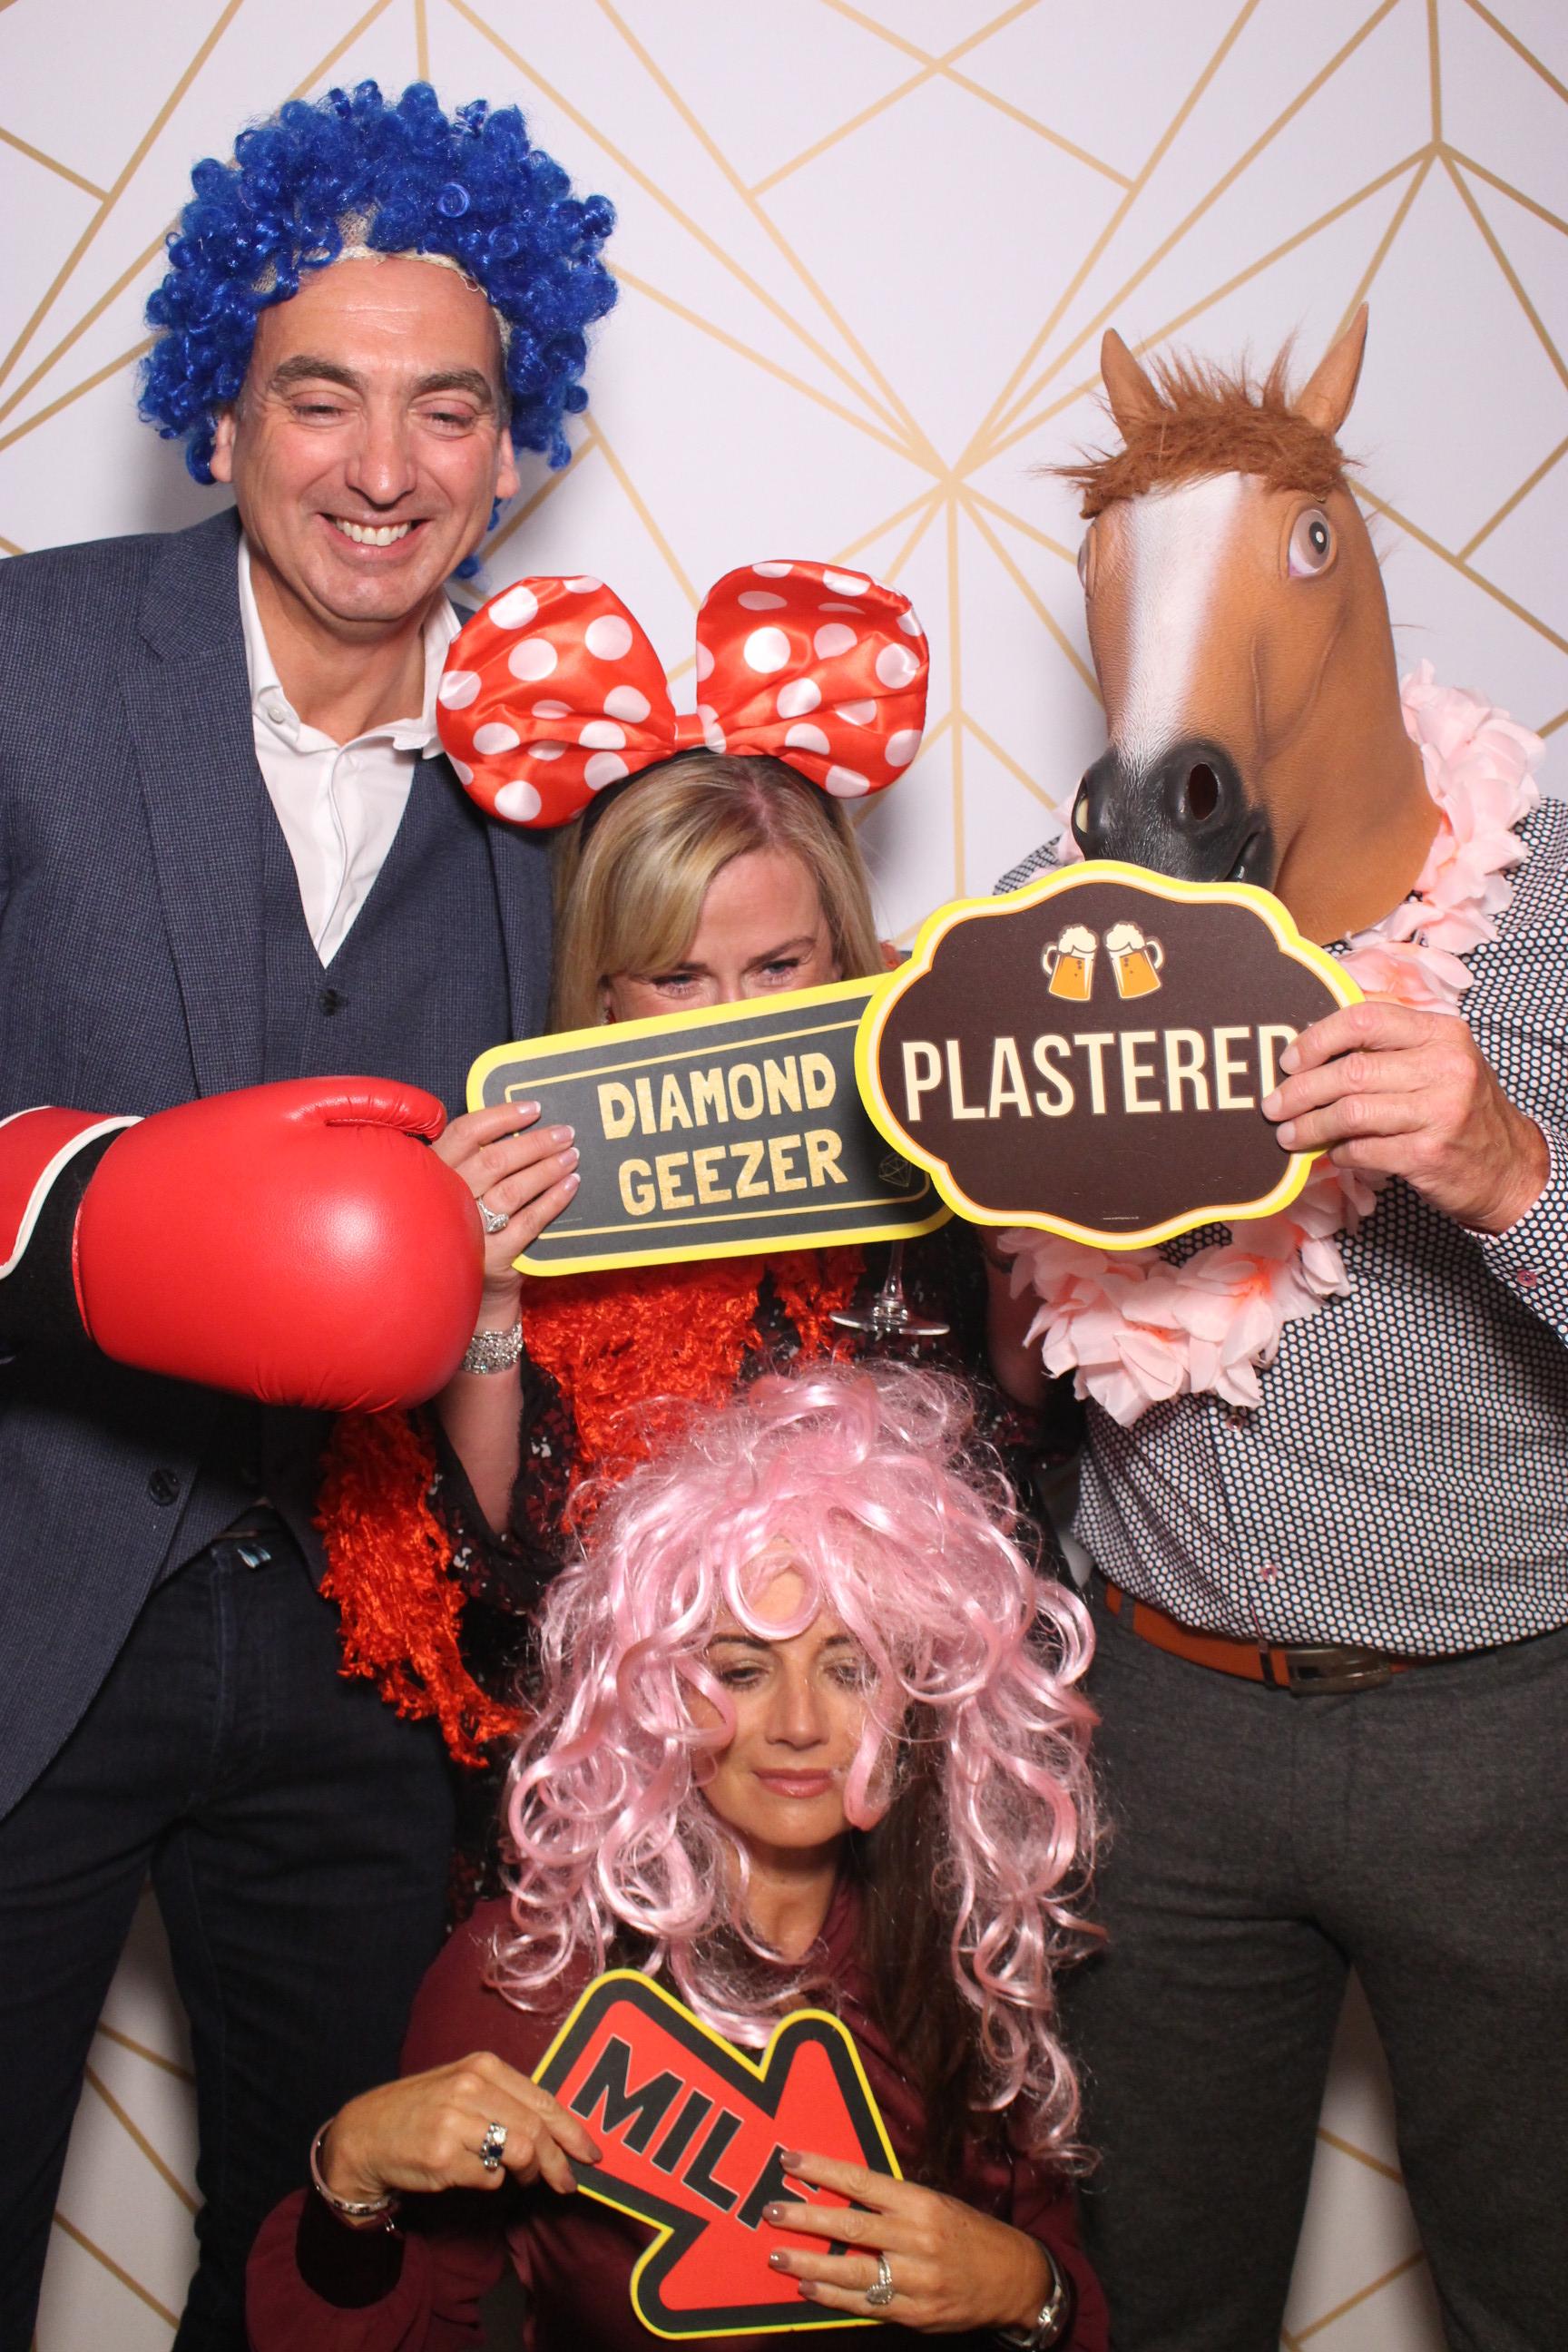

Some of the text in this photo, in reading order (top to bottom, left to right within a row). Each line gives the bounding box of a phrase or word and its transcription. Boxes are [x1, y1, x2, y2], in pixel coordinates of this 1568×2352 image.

[596, 1053, 838, 1141] DIAMOND
[901, 1024, 1299, 1122] PLASTERED
[617, 1129, 848, 1217] GEEZER
